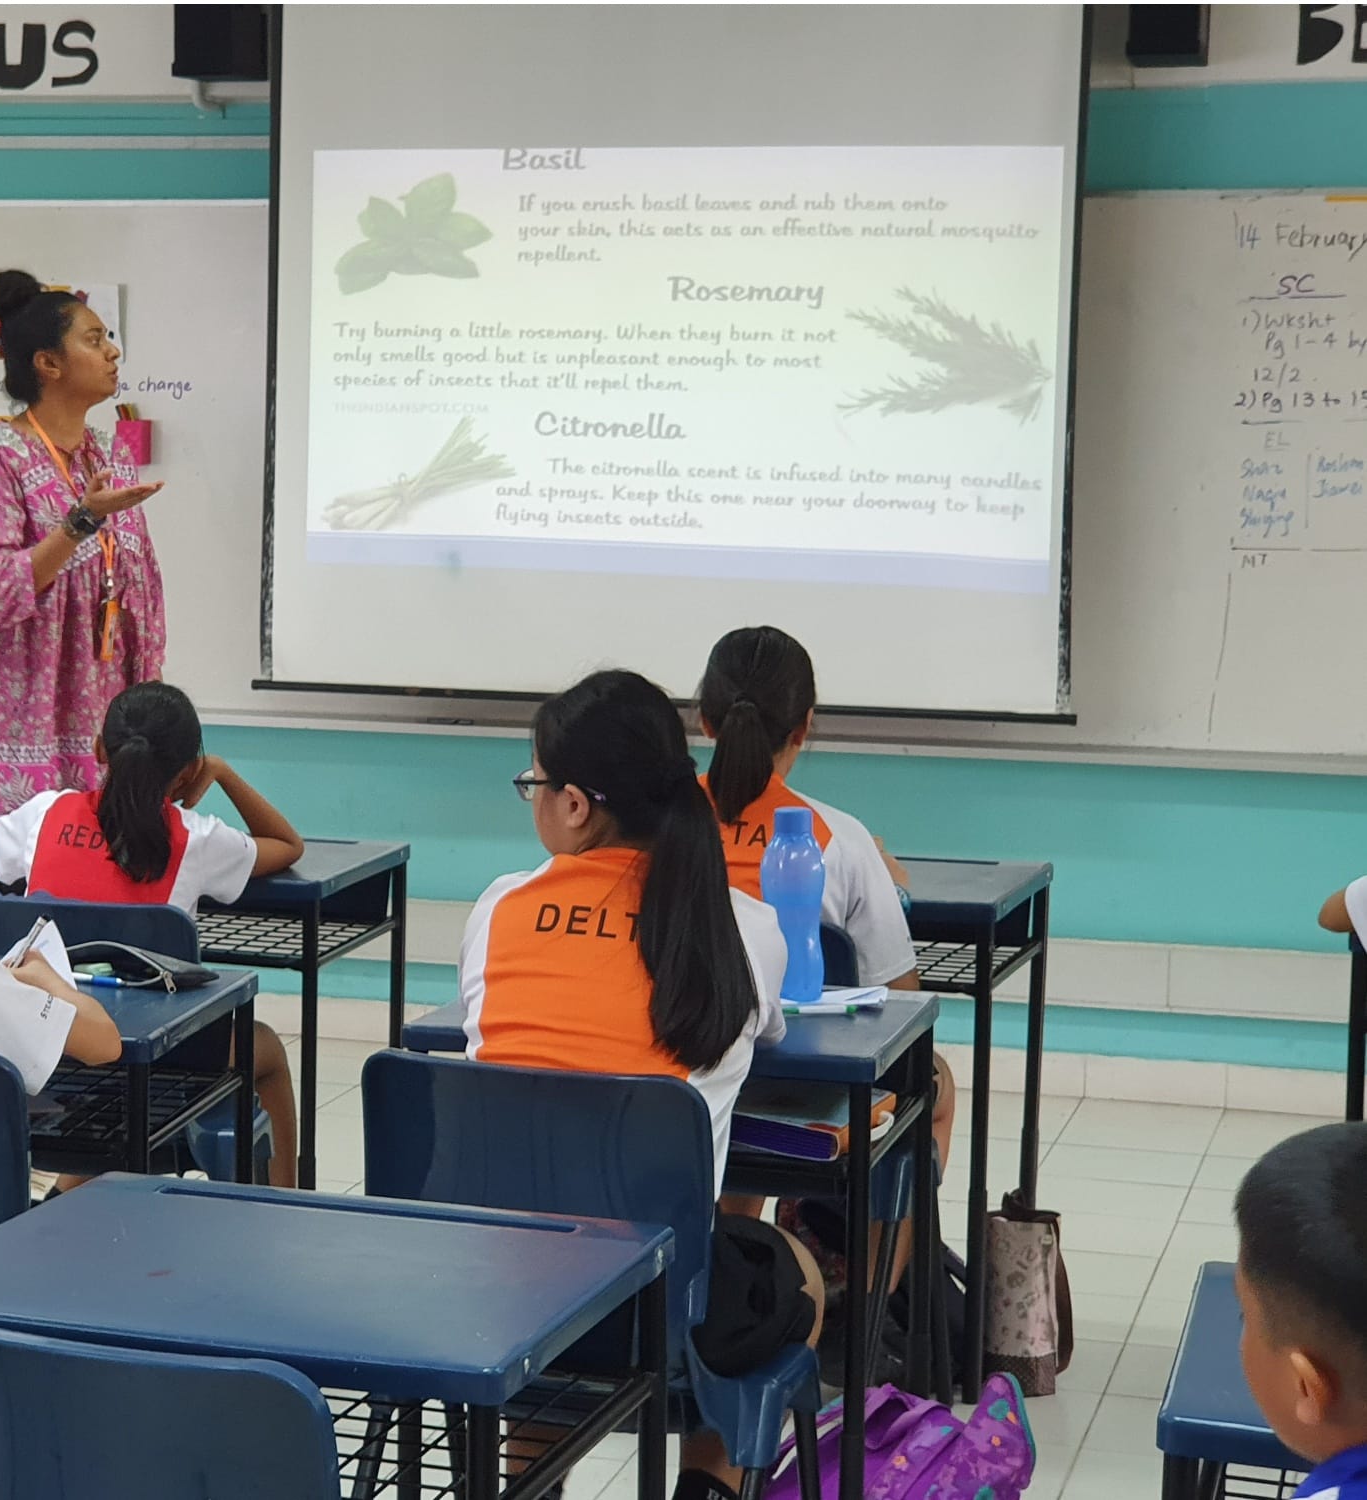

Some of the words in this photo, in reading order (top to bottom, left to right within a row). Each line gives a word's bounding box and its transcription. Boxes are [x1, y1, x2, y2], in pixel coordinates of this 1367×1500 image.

[502, 148, 586, 171] Basil
[519, 194, 536, 212] If
[541, 200, 576, 216] you
[582, 194, 635, 213] crush
[642, 193, 689, 213] basil
[695, 194, 752, 212] leaves
[759, 193, 798, 212] and
[804, 192, 835, 211] rub
[844, 193, 895, 211] them
[901, 197, 948, 211] onto
[519, 224, 560, 241] your
[567, 218, 612, 238] skin,
[619, 218, 655, 237] this
[663, 222, 704, 237] acts
[710, 226, 732, 237] as
[740, 225, 764, 237] an
[772, 217, 854, 238] effective
[861, 219, 934, 238] natural
[940, 223, 1041, 243] mosquito
[1275, 222, 1367, 262] February
[517, 244, 602, 267] repellent.
[667, 276, 825, 310] Rosemary
[1277, 273, 1315, 295] SC
[333, 321, 366, 342] Try
[373, 320, 442, 342] burning
[450, 328, 462, 338] a
[468, 321, 512, 339] little
[518, 328, 608, 344] rosemary.
[617, 323, 671, 342] When
[679, 323, 721, 345] they
[729, 323, 773, 342] burn
[781, 328, 796, 342] it
[803, 329, 838, 343] not
[1265, 331, 1285, 359] Pg
[333, 346, 372, 366] only
[379, 345, 435, 363] smells
[442, 346, 487, 367] good
[495, 347, 524, 364] but
[532, 352, 548, 364] is
[555, 347, 660, 370] unpleasant
[666, 348, 739, 371] enough
[745, 353, 766, 367] to
[772, 354, 823, 368] most
[138, 377, 193, 400] change
[333, 374, 396, 391] species
[404, 368, 425, 387] of
[428, 372, 493, 387] insects
[500, 371, 540, 389] that
[546, 373, 578, 390] it'll
[584, 372, 630, 395] repel
[636, 374, 689, 392] them.
[1234, 389, 1257, 410] 2)
[1262, 391, 1283, 413] Pg
[1292, 392, 1315, 408] 13
[534, 410, 686, 440] Citronella
[548, 457, 585, 475] The
[591, 460, 680, 478] citronella
[687, 466, 739, 480] scent
[746, 467, 762, 480] is
[770, 462, 841, 482] infused
[849, 469, 889, 484] into
[896, 474, 951, 490] many
[960, 472, 1042, 491] candles
[496, 481, 532, 497] and
[538, 486, 604, 504] sprays.
[612, 484, 658, 507] Keep
[666, 485, 703, 504] this
[710, 493, 745, 504] one
[752, 495, 794, 507] near
[802, 496, 845, 511] your
[853, 492, 936, 515] doorway
[946, 498, 969, 513] to
[976, 495, 1025, 521] keep
[495, 502, 549, 527] flying
[557, 510, 625, 526] insects
[629, 511, 704, 529] outside.
